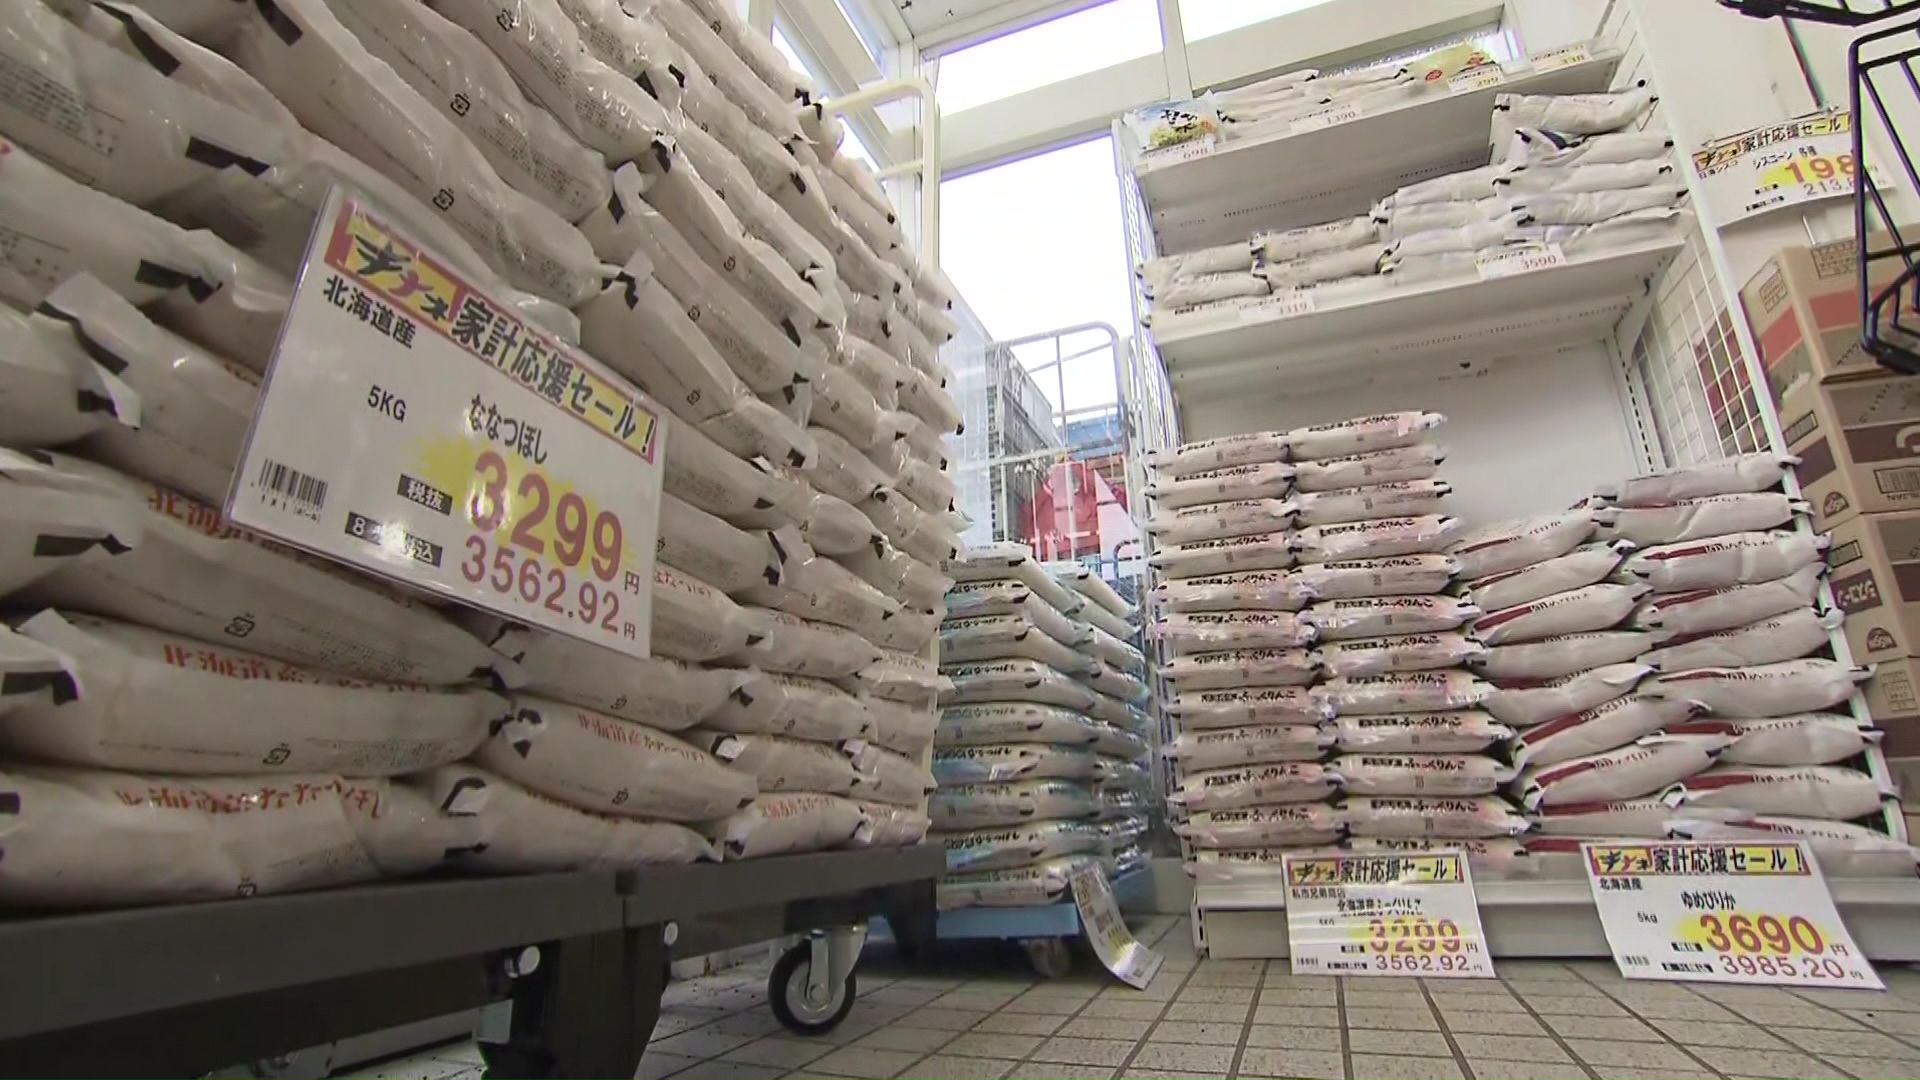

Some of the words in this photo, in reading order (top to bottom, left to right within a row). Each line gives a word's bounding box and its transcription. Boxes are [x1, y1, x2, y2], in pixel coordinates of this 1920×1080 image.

[322, 274, 416, 349] 北海道産
[451, 297, 655, 456] 家計応援セール！
[367, 385, 408, 423] 5KG
[469, 393, 549, 465] ななつぼし
[406, 479, 445, 511] 税抜
[1653, 846, 1804, 873] 家計応援セール！
[1599, 877, 1643, 891] 北海道産
